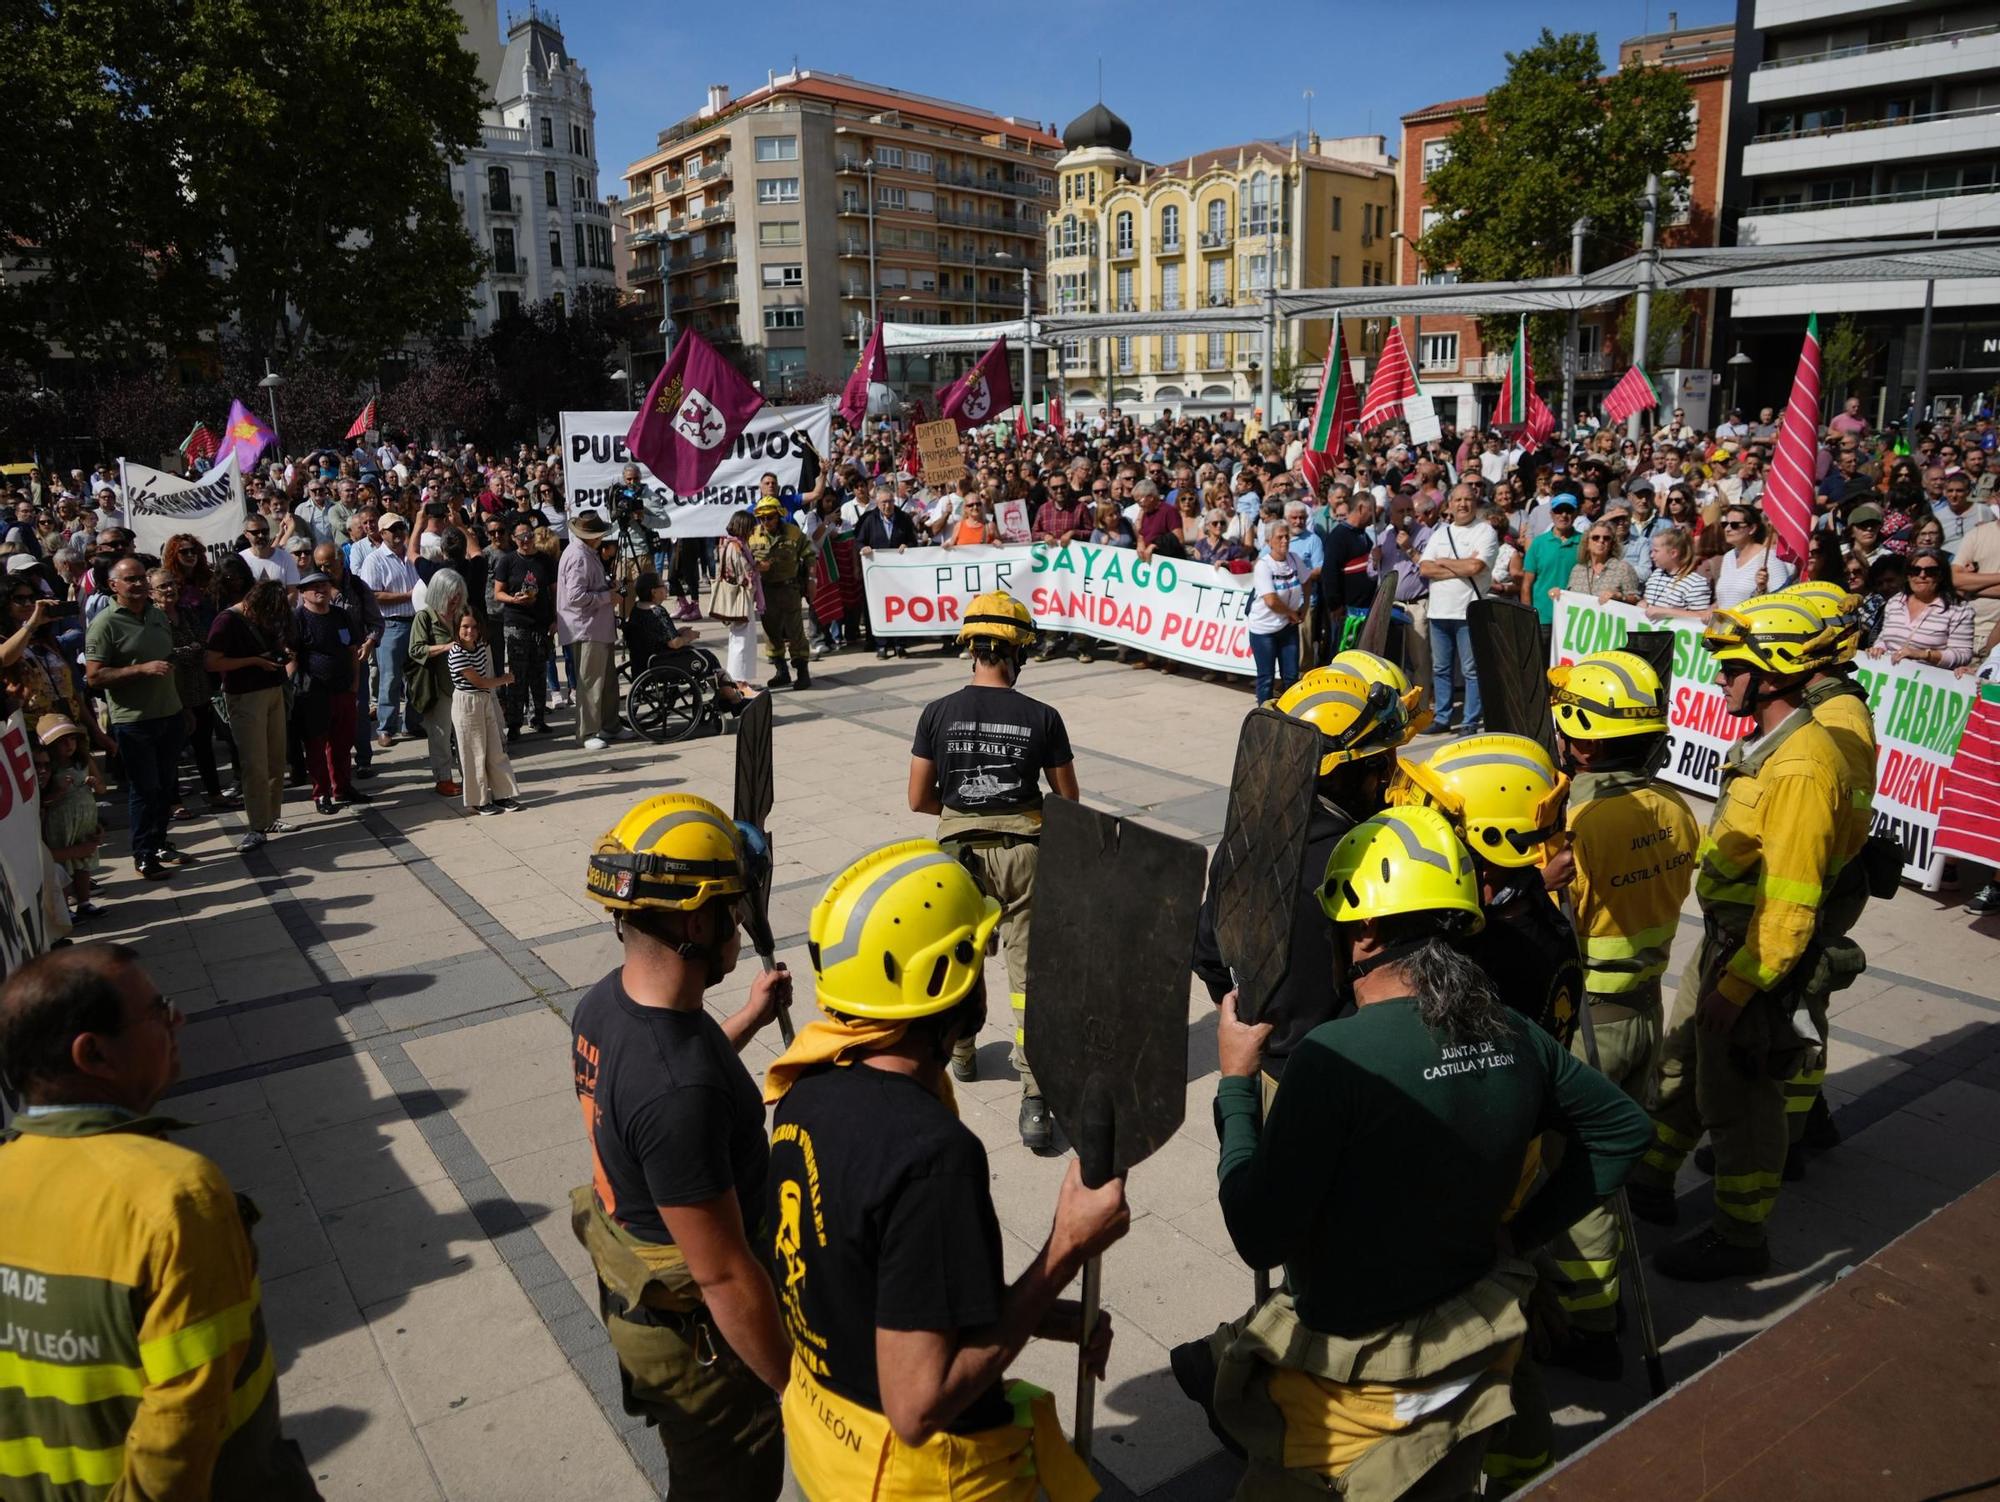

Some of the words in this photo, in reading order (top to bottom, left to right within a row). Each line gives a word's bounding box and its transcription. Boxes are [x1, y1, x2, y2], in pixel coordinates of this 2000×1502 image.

[1984, 338, 2000, 352] N
[935, 437, 946, 448] EN
[927, 467, 965, 483] ECHAMOS
[1031, 542, 1177, 593] SAYAGO
[936, 562, 1013, 594] POR
[1083, 577, 1115, 599] EL
[1191, 583, 1250, 621] TRE
[885, 595, 959, 623] POR
[1031, 587, 1152, 635] SANIDAD
[1160, 612, 1253, 658] PUBLIC
[1562, 605, 1627, 655] ZONA
[1623, 707, 1661, 718] uve
[1013, 747, 1022, 756] 2
[1659, 826, 1673, 841] DE
[1441, 1044, 1478, 1060] JUNTA
[1479, 1041, 1495, 1054] DE
[1423, 1059, 1477, 1080] CASTILLA
[1476, 1057, 1486, 1069] Y
[1488, 1052, 1515, 1068] LEÓN
[23, 1273, 47, 1305] DE
[16, 1325, 29, 1353] Y
[33, 1328, 101, 1362] LEÓN
[818, 1401, 862, 1453] LEÓN
